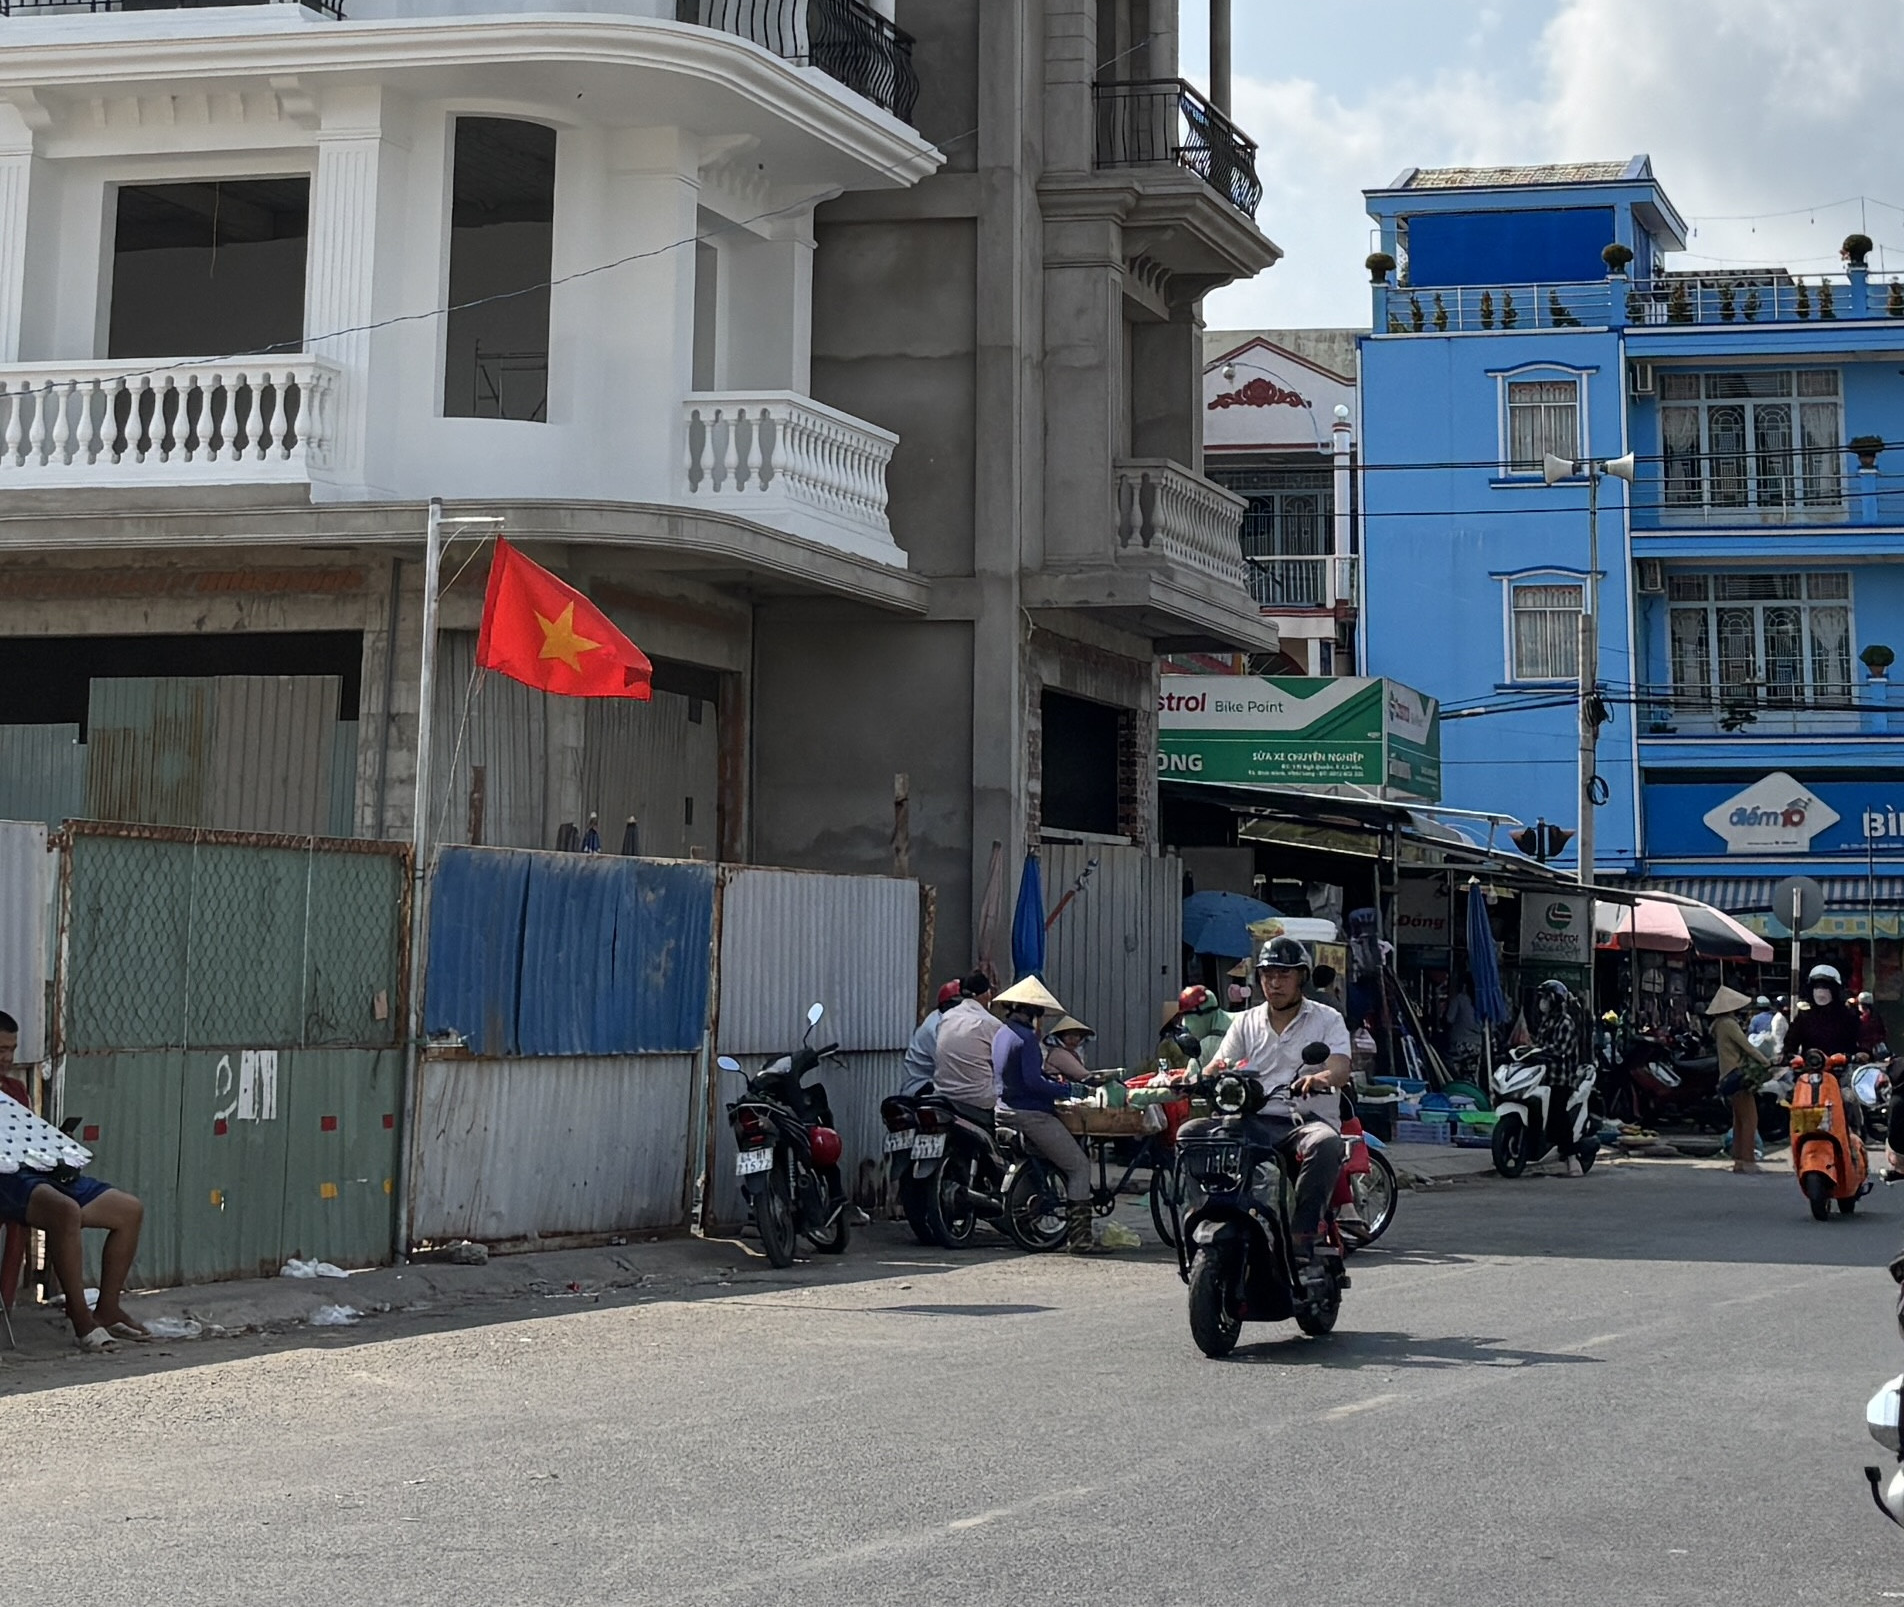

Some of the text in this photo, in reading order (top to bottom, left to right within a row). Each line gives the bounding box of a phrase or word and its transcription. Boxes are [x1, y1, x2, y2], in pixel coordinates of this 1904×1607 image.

[1158, 692, 1284, 713] strol Bike Point
